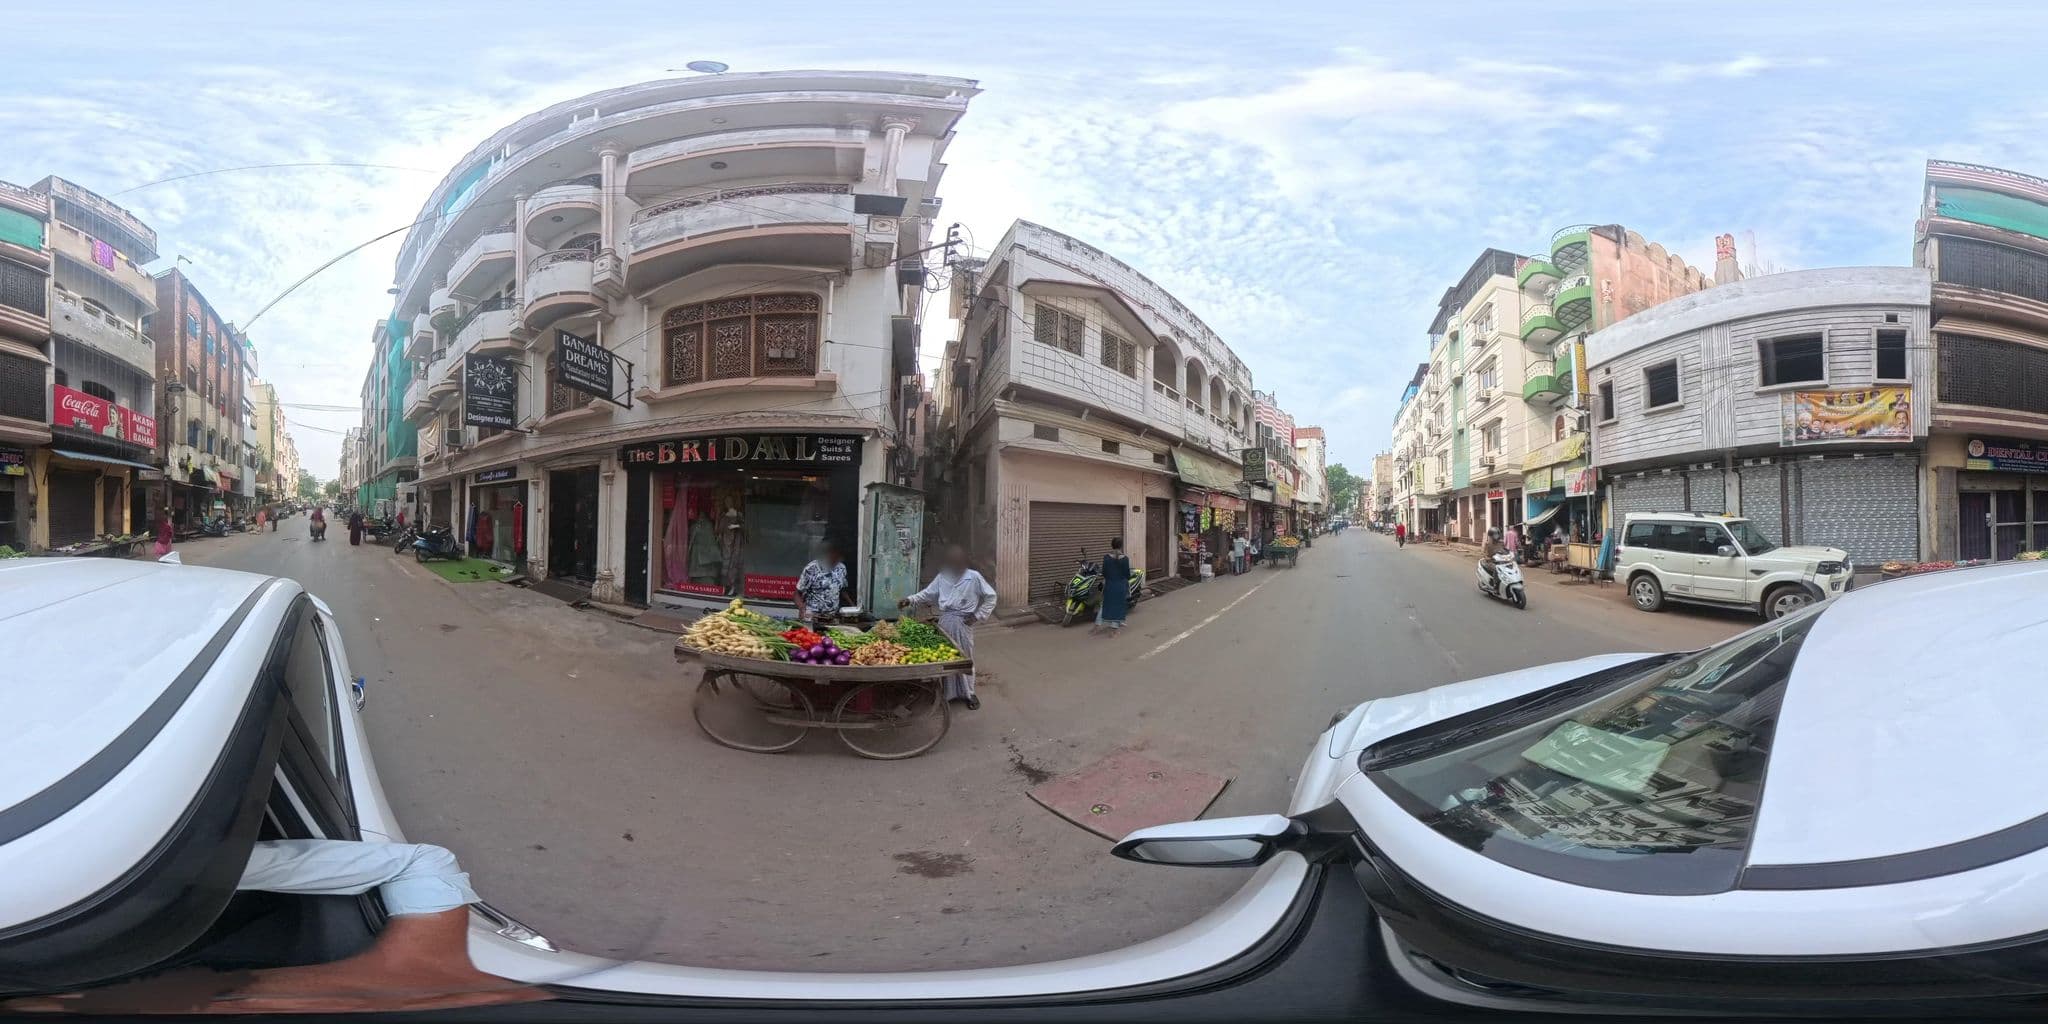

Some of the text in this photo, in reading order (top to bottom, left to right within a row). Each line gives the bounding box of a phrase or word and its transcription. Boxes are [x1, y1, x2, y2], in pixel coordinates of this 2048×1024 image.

[563, 334, 610, 363] BANARAS
[566, 349, 608, 375] DREAMS
[132, 413, 154, 429] AKASH
[467, 412, 494, 423] Designer
[136, 423, 151, 436] MILK
[132, 432, 154, 446] BAHAR
[818, 437, 855, 446] Designer
[820, 445, 842, 453] Suits
[1987, 447, 2034, 460] DENTAL
[627, 449, 655, 463] The
